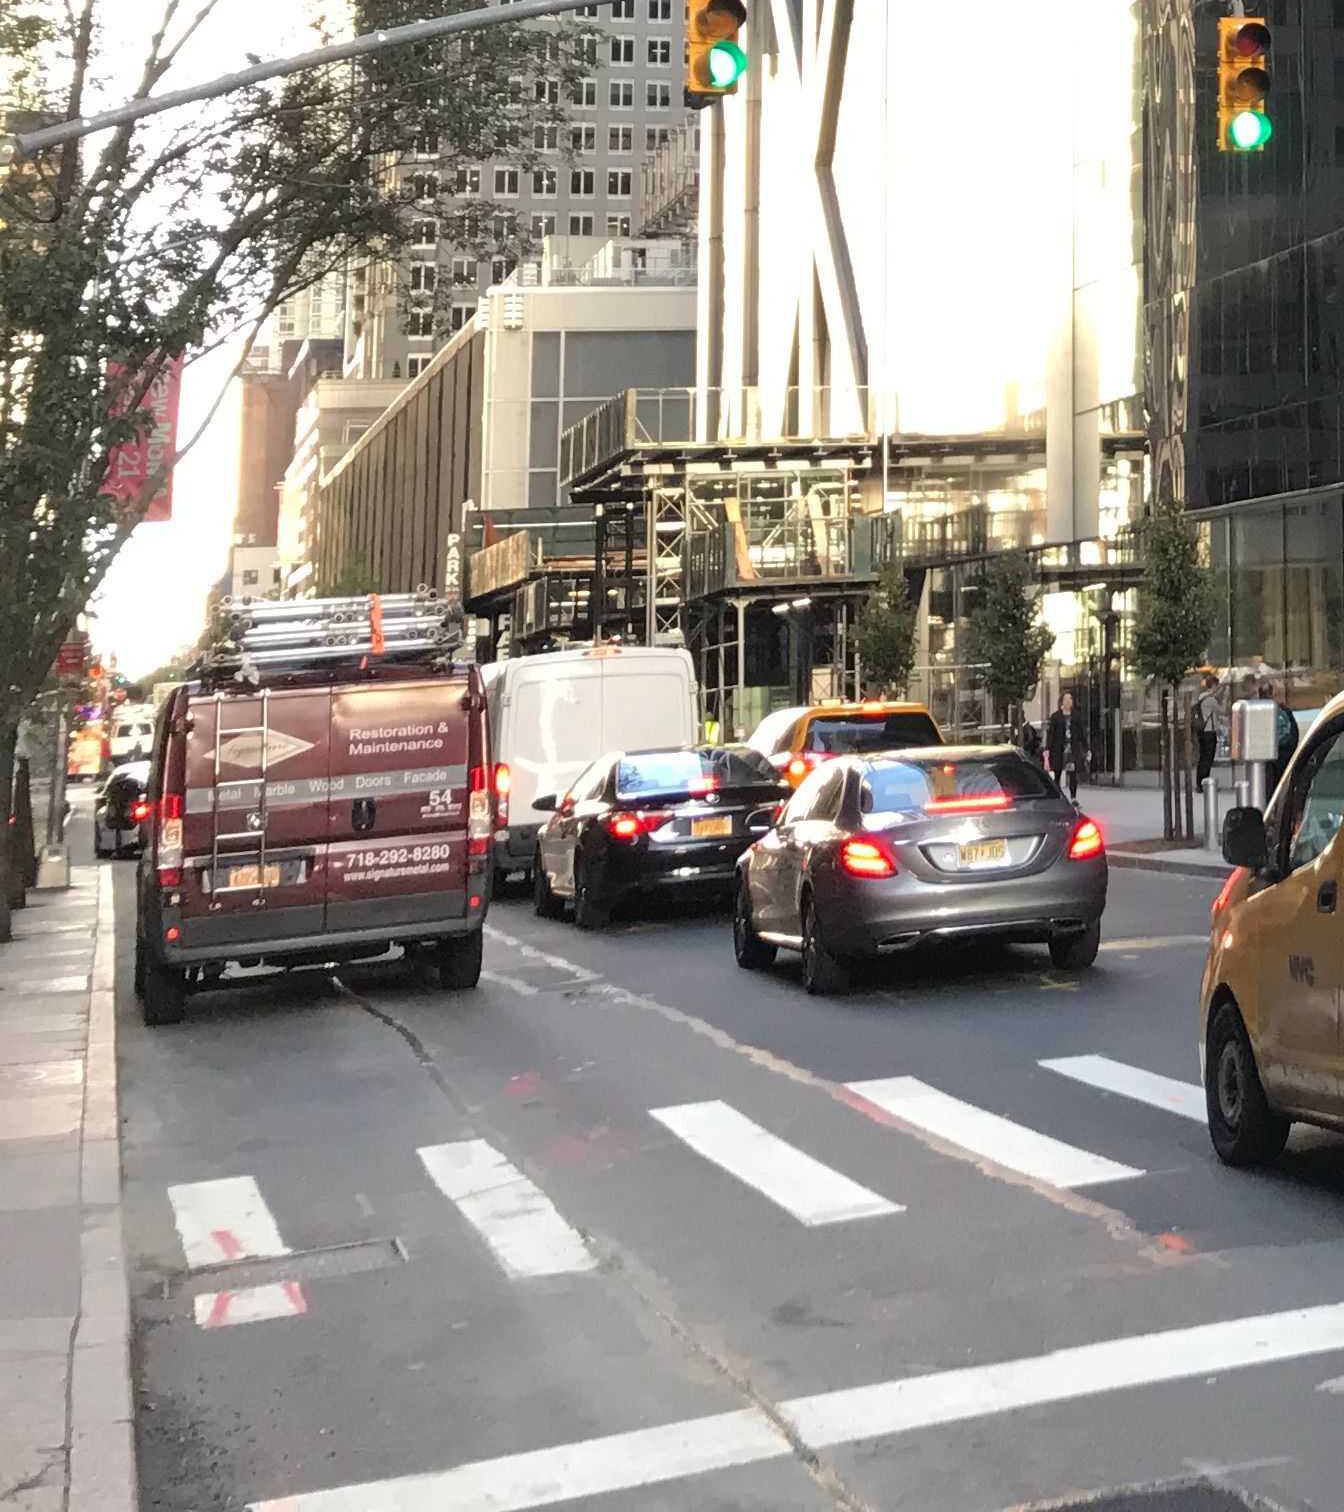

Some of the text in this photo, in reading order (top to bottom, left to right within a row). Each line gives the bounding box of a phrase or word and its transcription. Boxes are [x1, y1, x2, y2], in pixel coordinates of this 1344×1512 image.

[117, 450, 143, 478] 21
[445, 533, 461, 586] PARK
[348, 721, 449, 741] Restoration &
[348, 737, 444, 756] Maintenance
[308, 778, 344, 792] Wood
[355, 775, 392, 789] Doors
[403, 770, 448, 784] Facade
[429, 789, 452, 806] 54
[346, 843, 450, 868] 718-292-8280
[343, 862, 450, 883] www.signaturemetal.com
